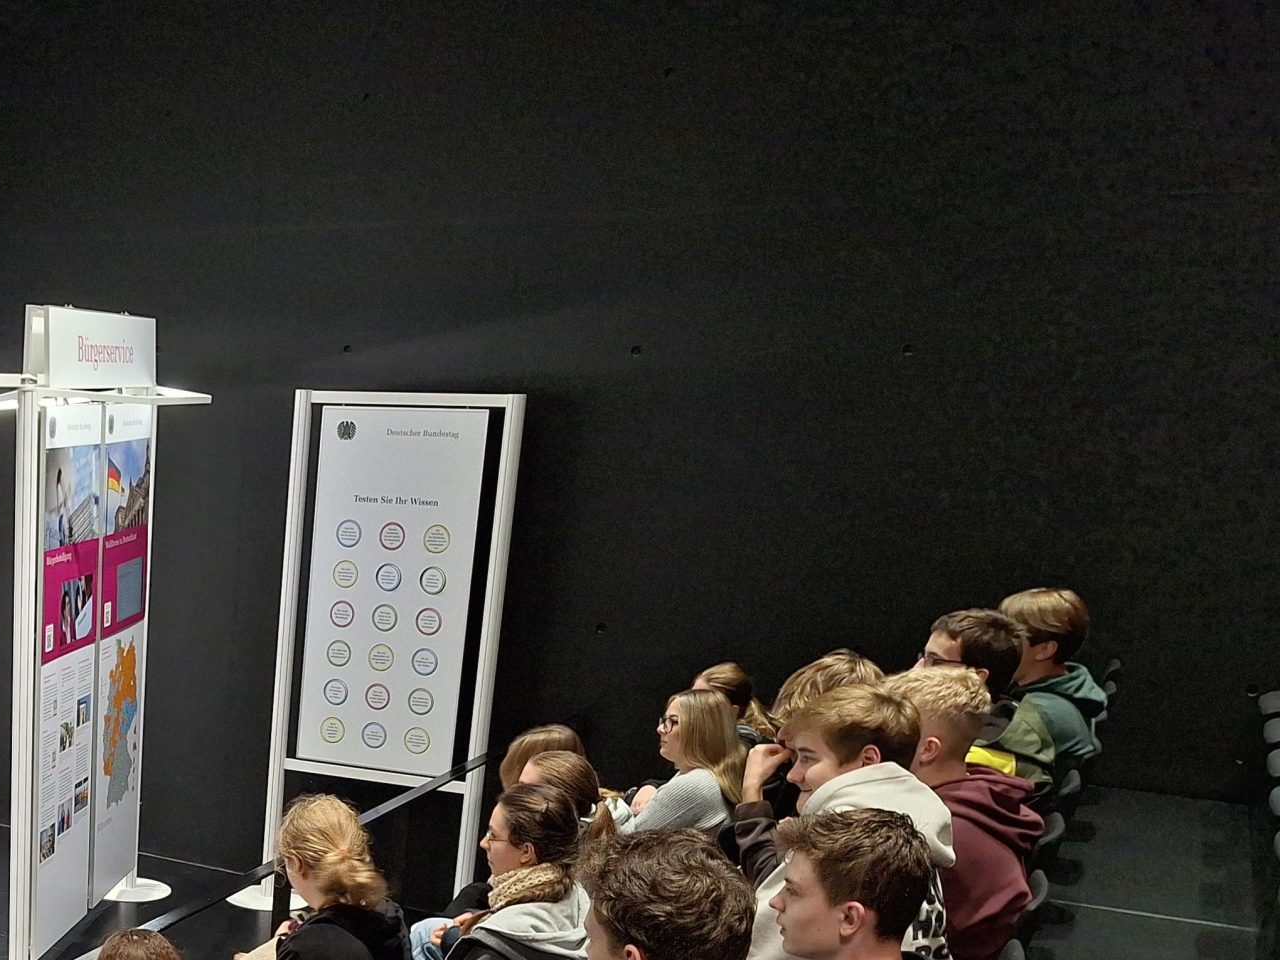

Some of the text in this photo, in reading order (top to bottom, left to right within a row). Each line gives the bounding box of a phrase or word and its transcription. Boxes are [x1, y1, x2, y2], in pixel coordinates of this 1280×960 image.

[78, 336, 133, 370] Bürgerservice
[386, 428, 459, 439] Deutscher Bundestag
[354, 495, 378, 503] Testen
[380, 496, 393, 504] Sie
[410, 497, 438, 506] Wissen
